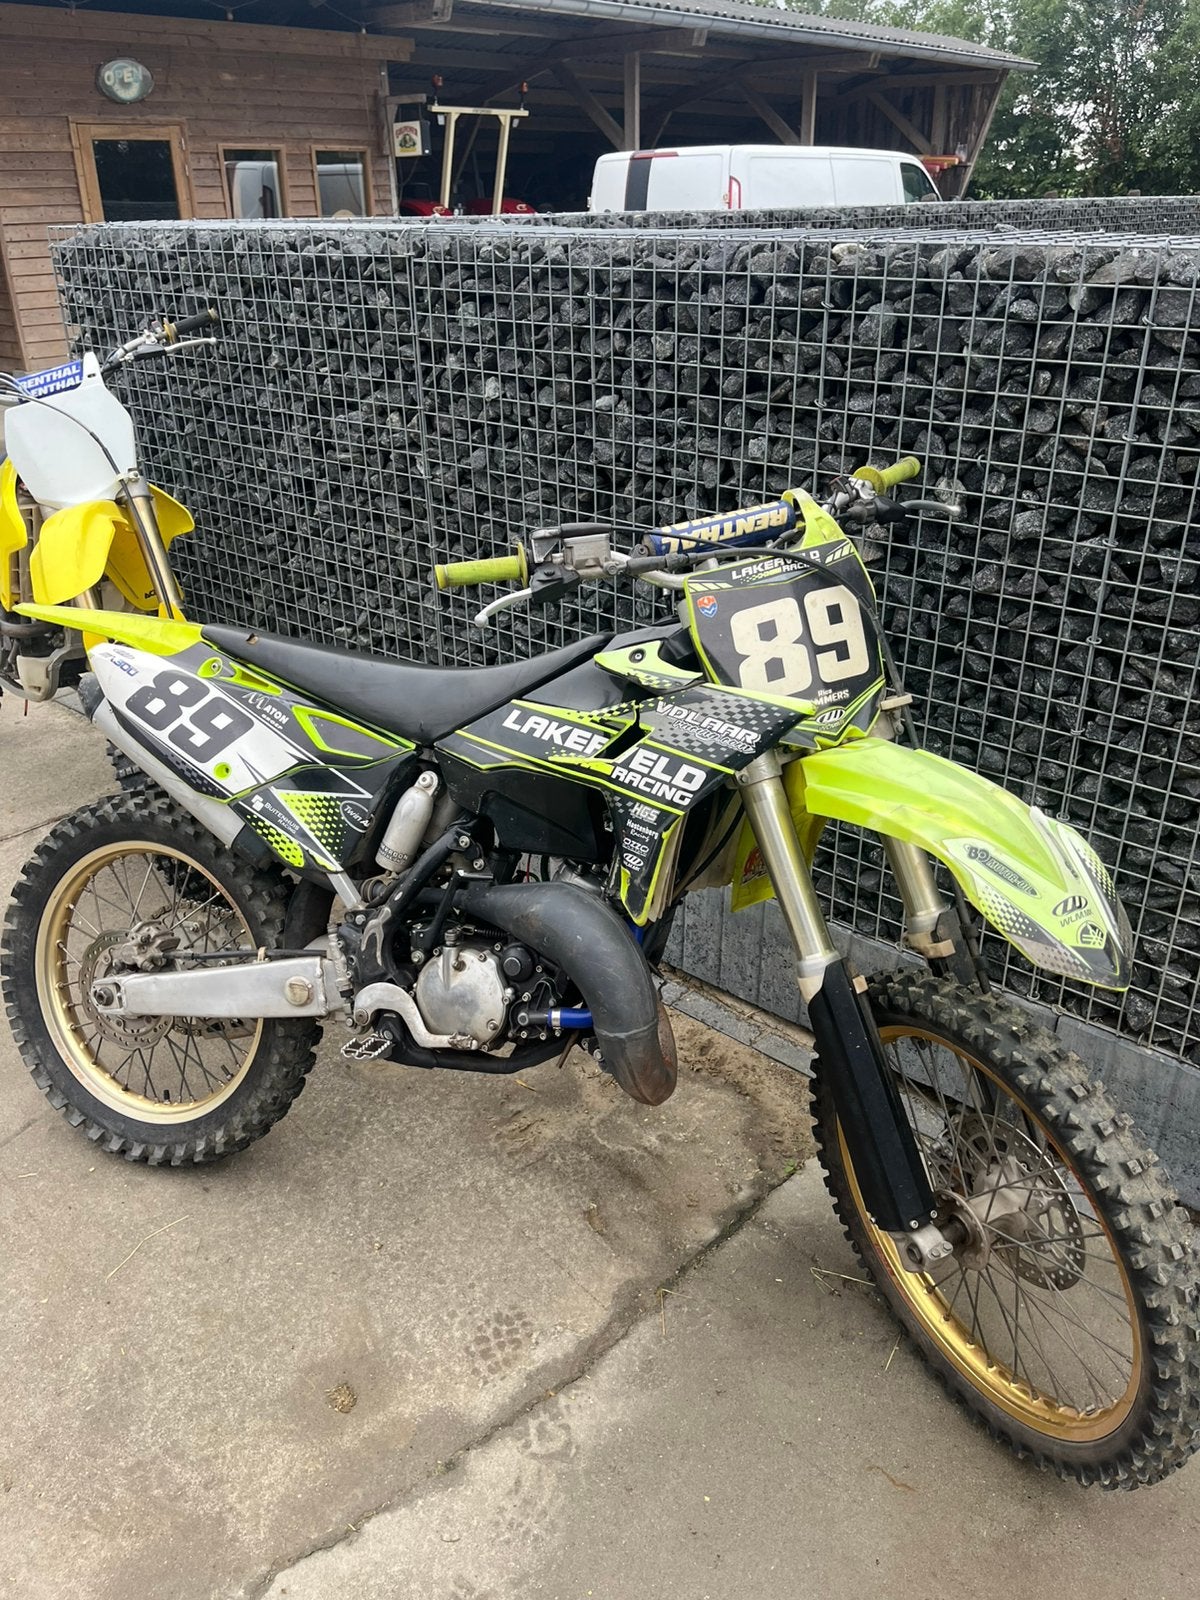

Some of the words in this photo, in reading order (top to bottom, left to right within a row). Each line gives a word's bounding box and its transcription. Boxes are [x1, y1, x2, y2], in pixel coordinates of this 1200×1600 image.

[31, 375, 83, 398] ENTHAL
[662, 506, 789, 555] RENTHAL
[730, 585, 869, 696] 89
[126, 670, 255, 764] 89
[656, 700, 762, 748] VDLAAR
[611, 766, 694, 806] RACING
[343, 804, 362, 823] Twin
[631, 802, 661, 822] HGS
[623, 837, 650, 853] OZZO
